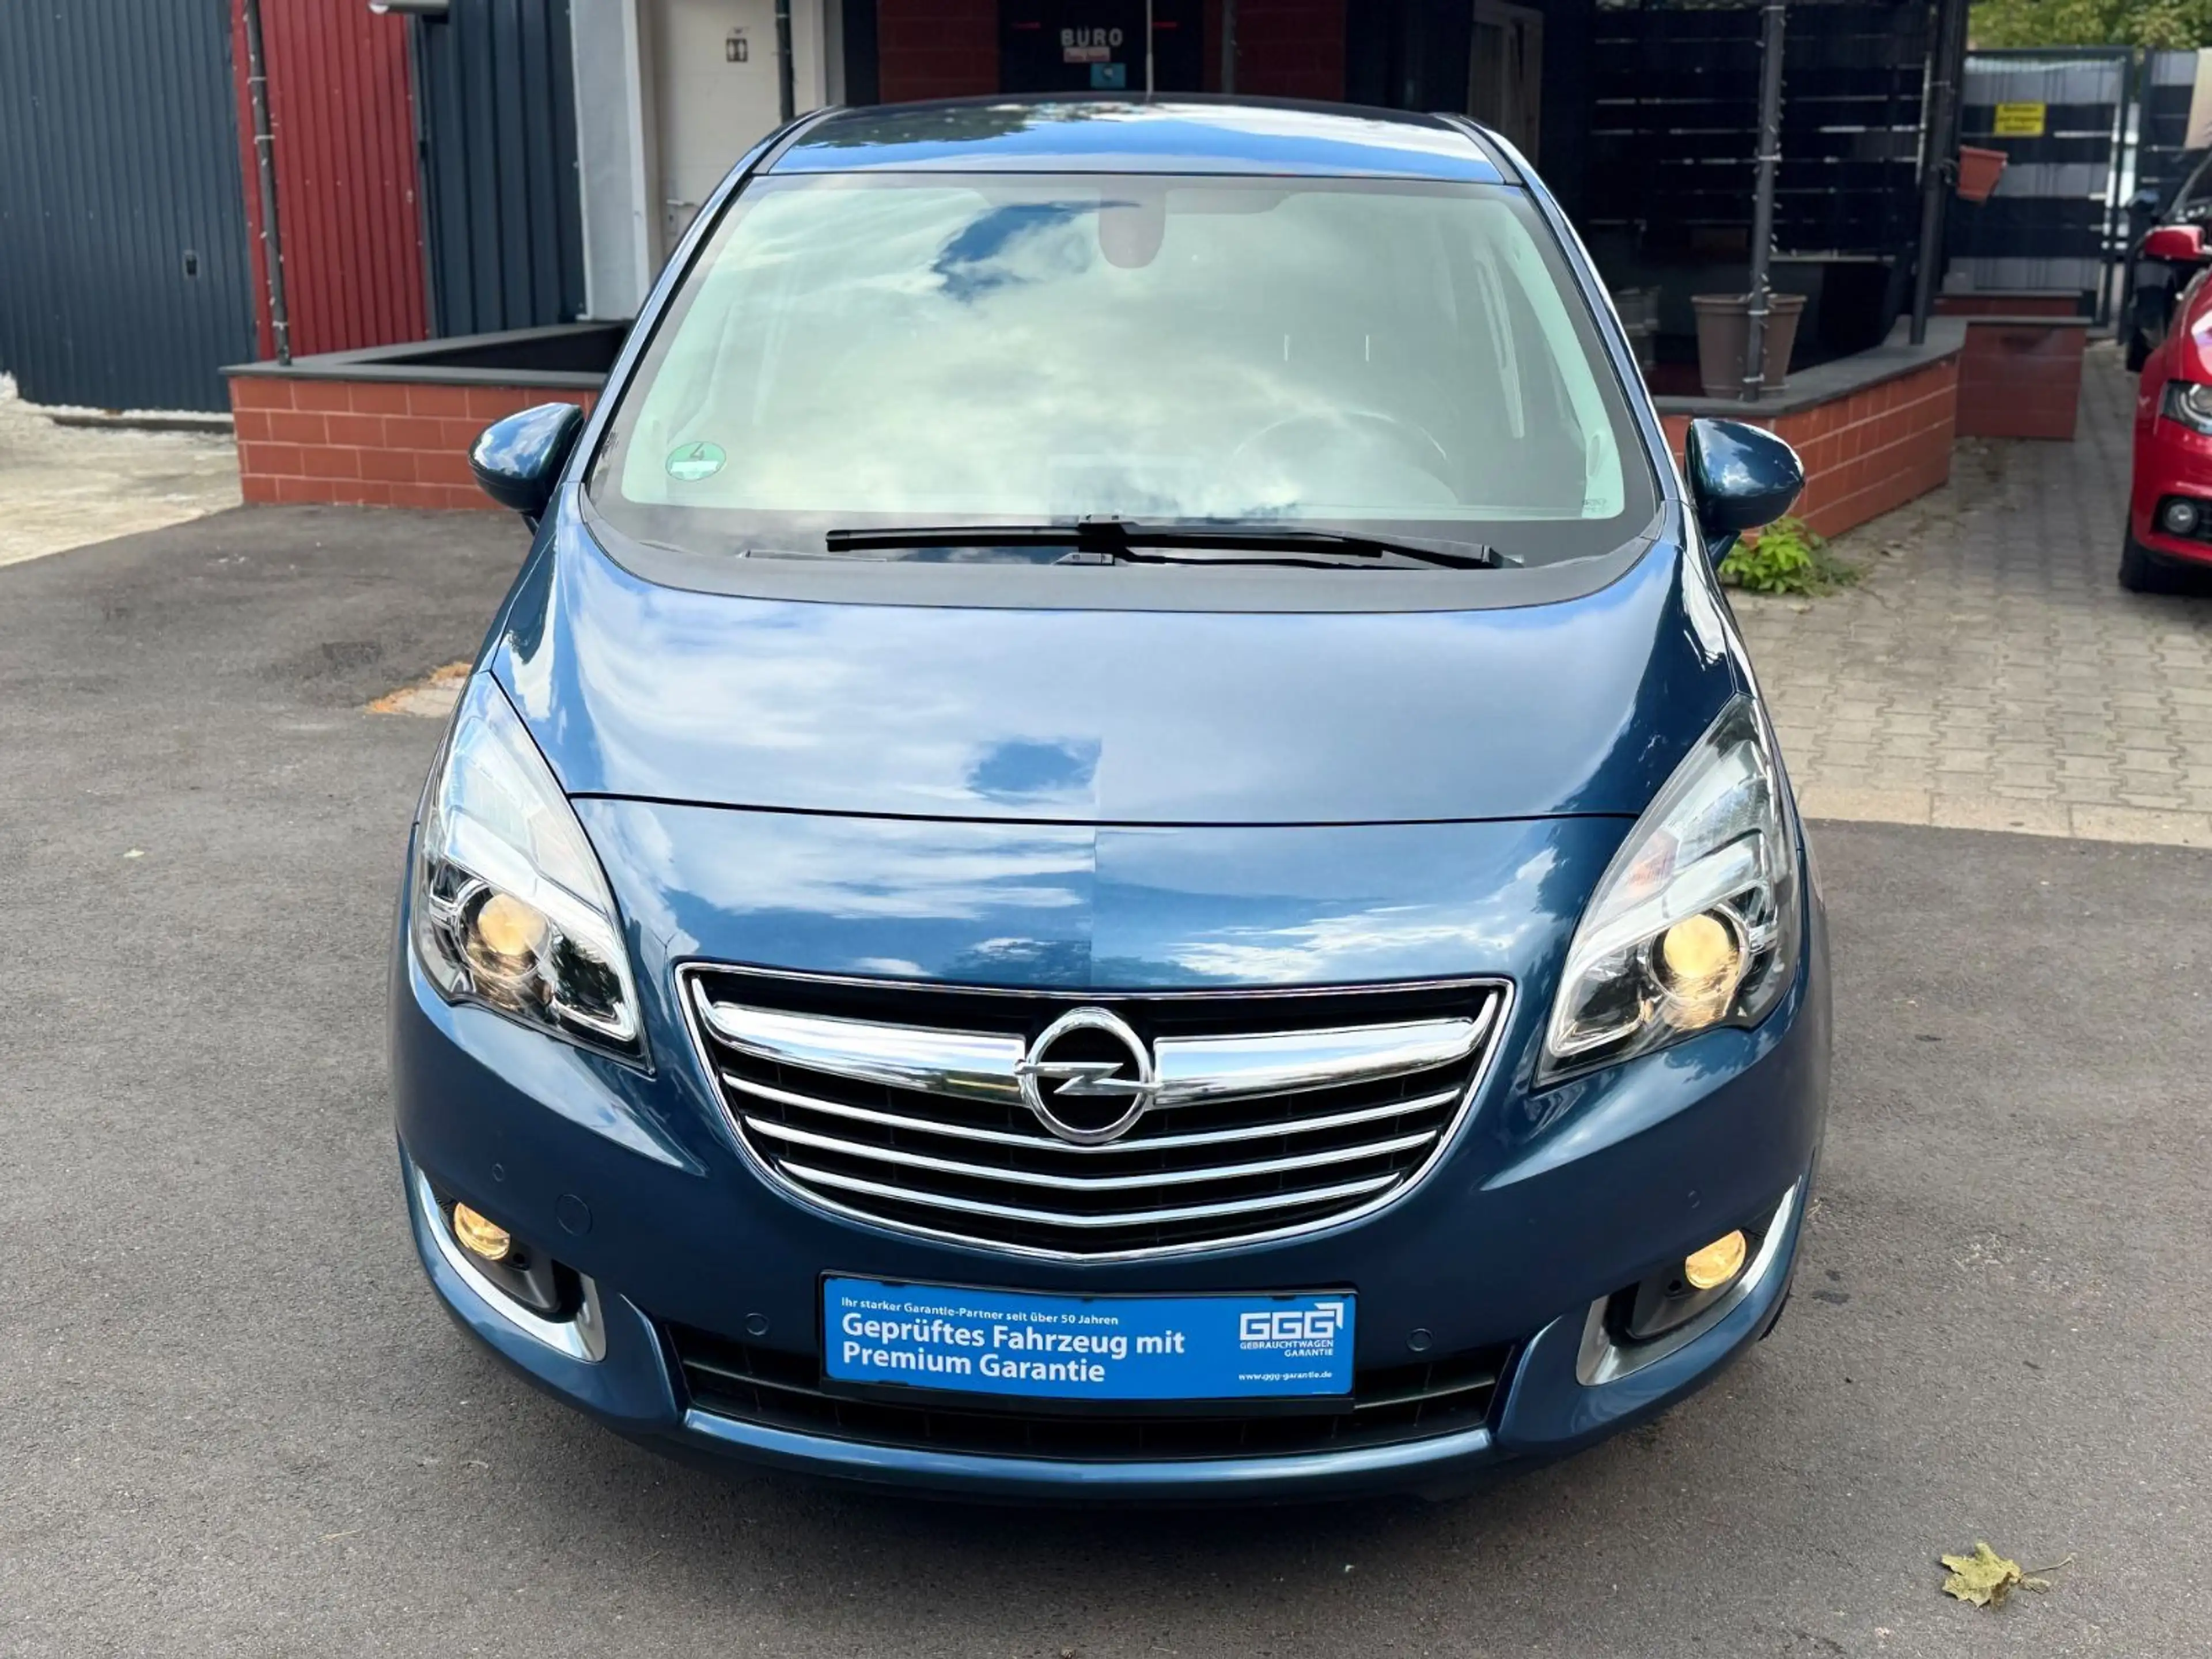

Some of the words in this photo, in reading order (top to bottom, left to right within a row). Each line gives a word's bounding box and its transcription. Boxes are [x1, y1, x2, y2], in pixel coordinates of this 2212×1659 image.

[842, 1297, 857, 1306] Ihr
[861, 1301, 901, 1312] starker
[904, 1302, 1003, 1320] Garantie-Partner
[1006, 1312, 1028, 1321] seit
[1031, 1312, 1058, 1323] über
[1062, 1315, 1075, 1324] 50
[1078, 1315, 1118, 1325] Jahren
[1240, 1310, 1335, 1340] GGG
[842, 1312, 985, 1347] Geprüftes
[993, 1325, 1128, 1360] Fahrzeug
[1136, 1330, 1185, 1354] mit
[1240, 1340, 1334, 1350] GEBRAUCHTWAGEN
[843, 1341, 971, 1375] Premium
[979, 1354, 1105, 1382] Garantie
[1284, 1348, 1334, 1357] GARANTIE
